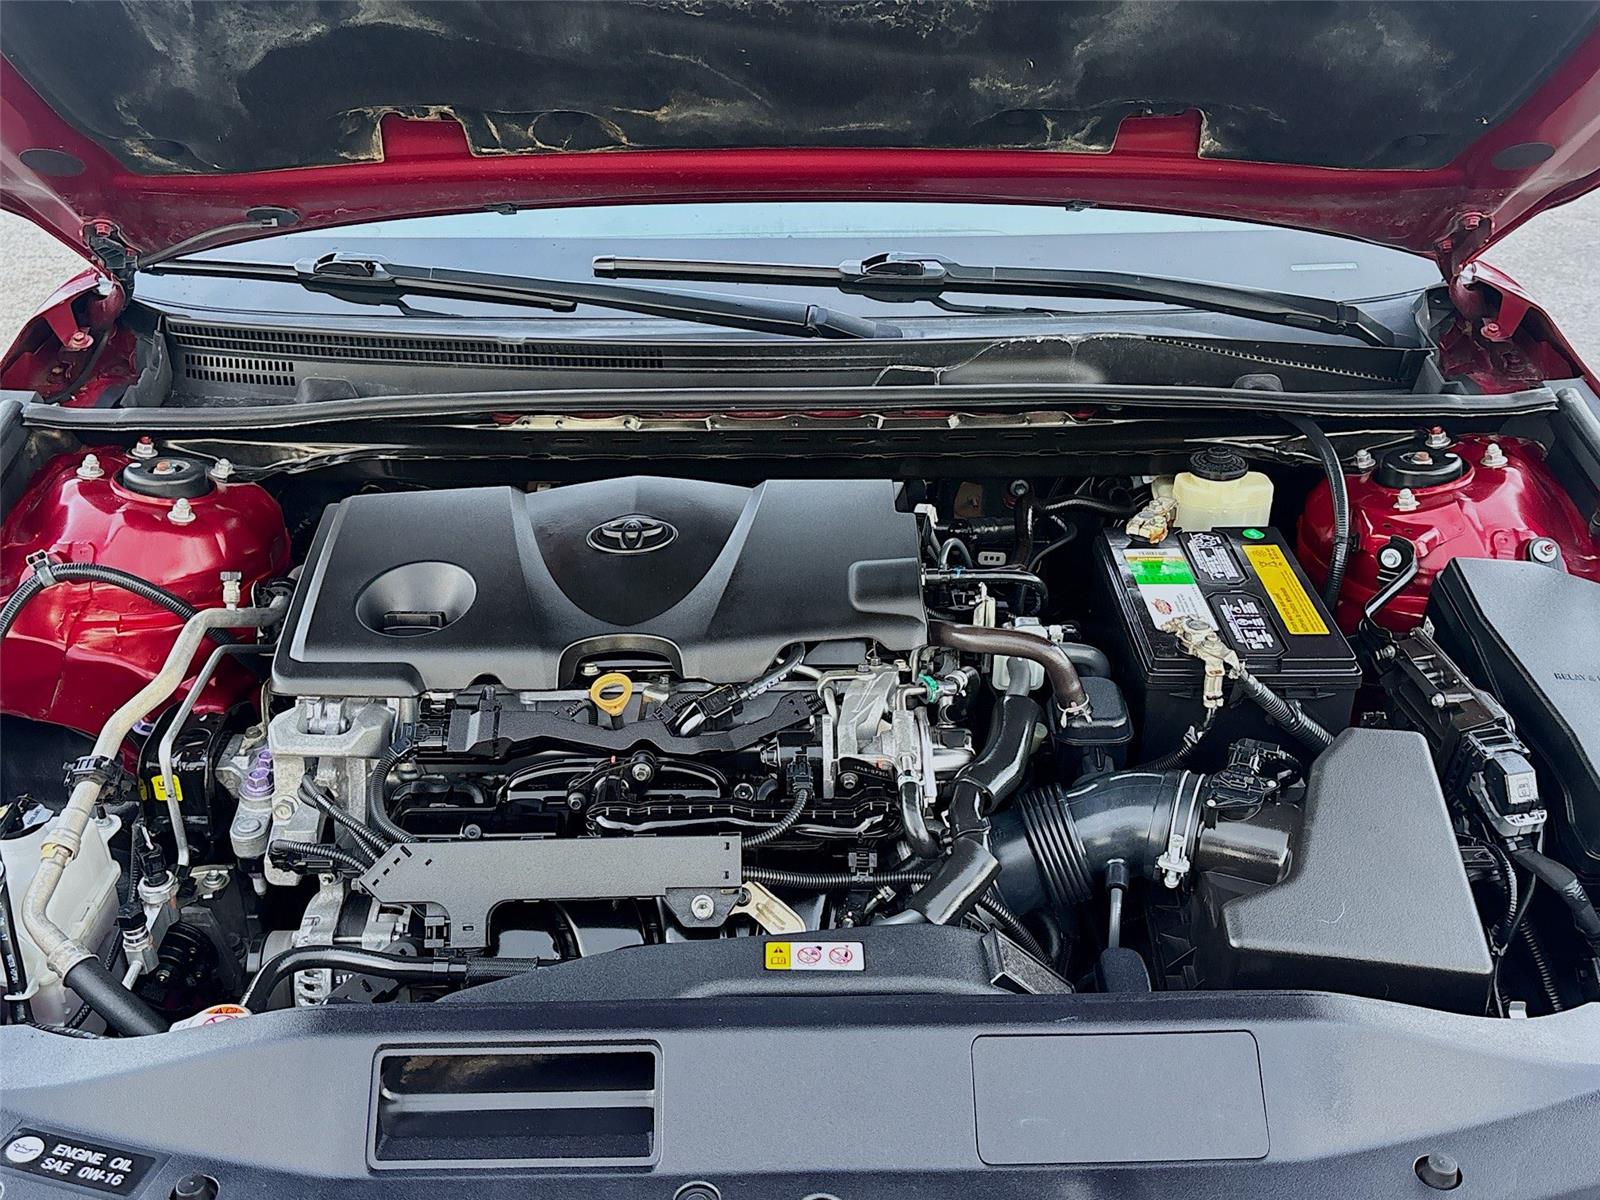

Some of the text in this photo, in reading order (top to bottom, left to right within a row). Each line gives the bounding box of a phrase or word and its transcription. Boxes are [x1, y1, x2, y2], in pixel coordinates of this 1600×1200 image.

[1553, 672, 1585, 681] RELAY
[40, 1157, 125, 1186] SAE 0W-16
[51, 1143, 133, 1172] ENGINE OIL
